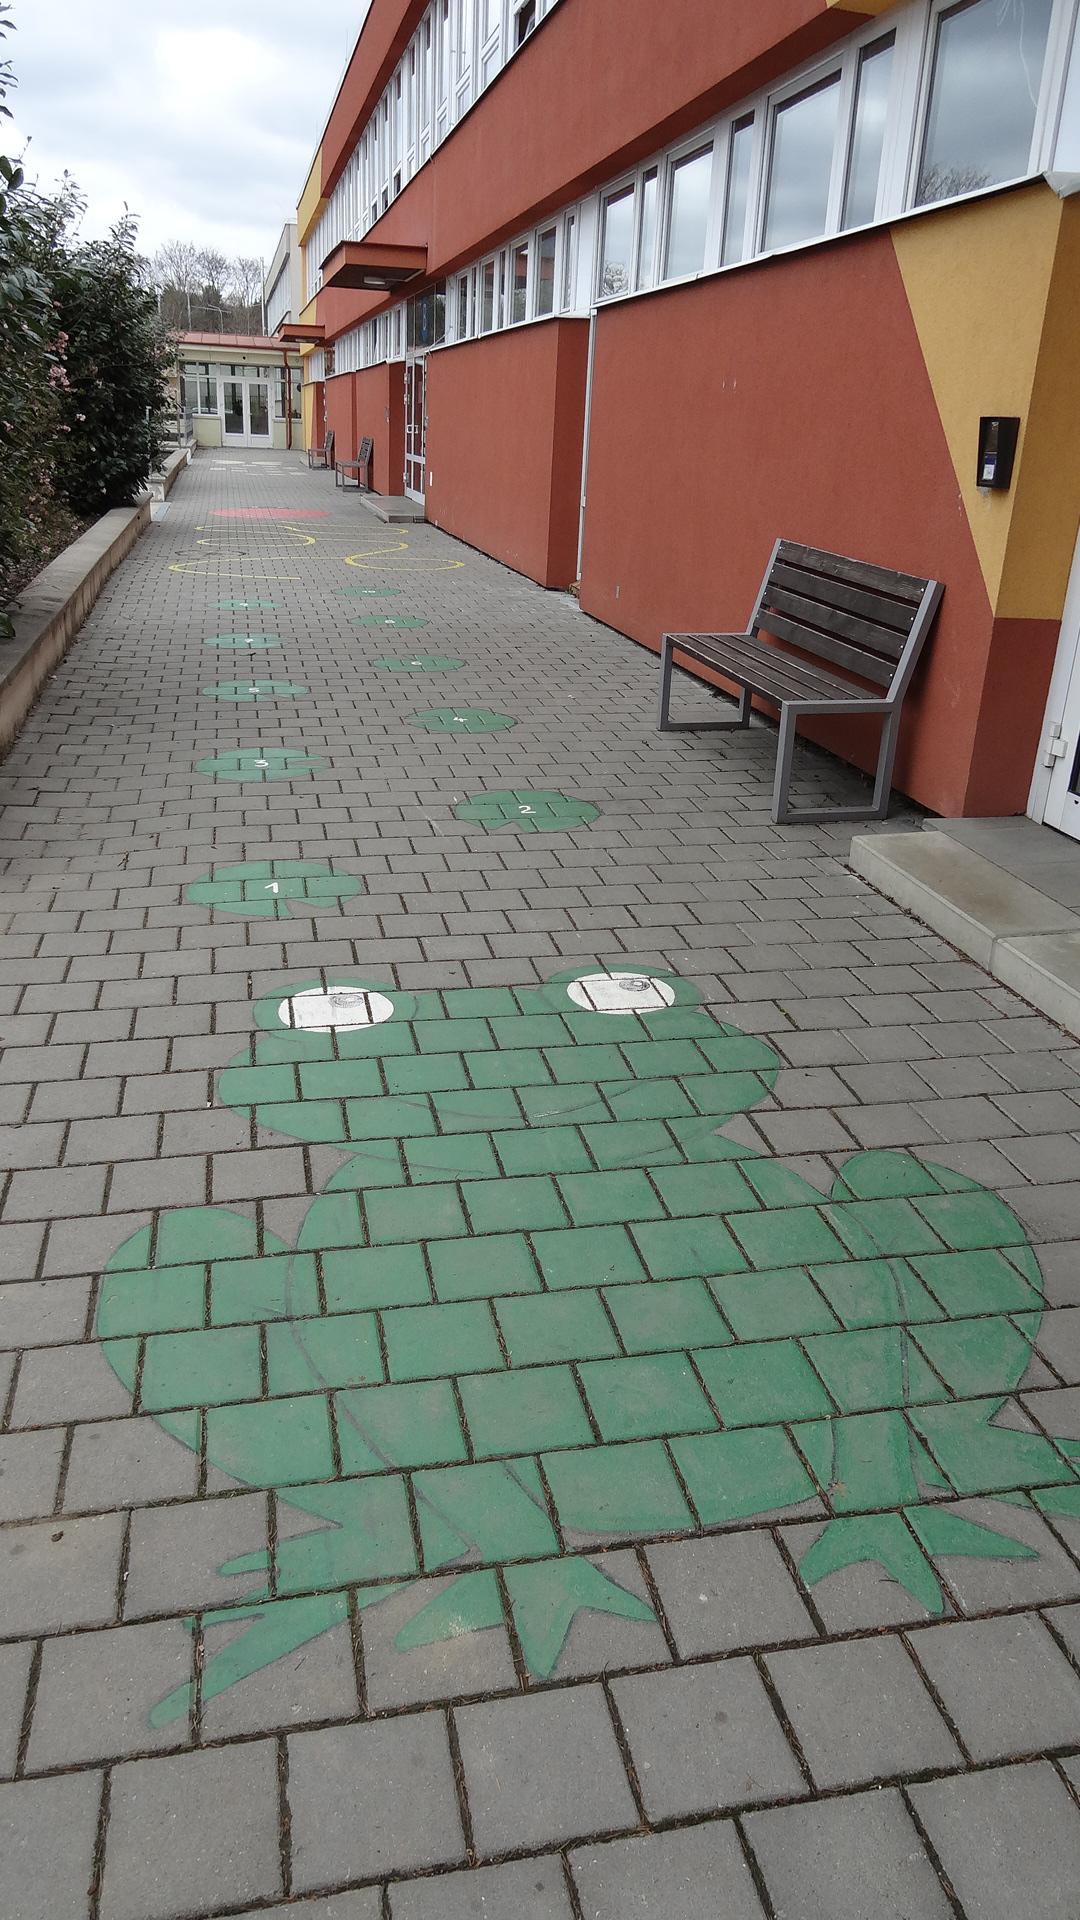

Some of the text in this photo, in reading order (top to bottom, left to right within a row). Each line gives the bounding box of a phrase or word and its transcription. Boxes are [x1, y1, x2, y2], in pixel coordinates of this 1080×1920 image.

[254, 759, 269, 768] 3
[518, 804, 537, 814] 2
[264, 881, 279, 894] 1
